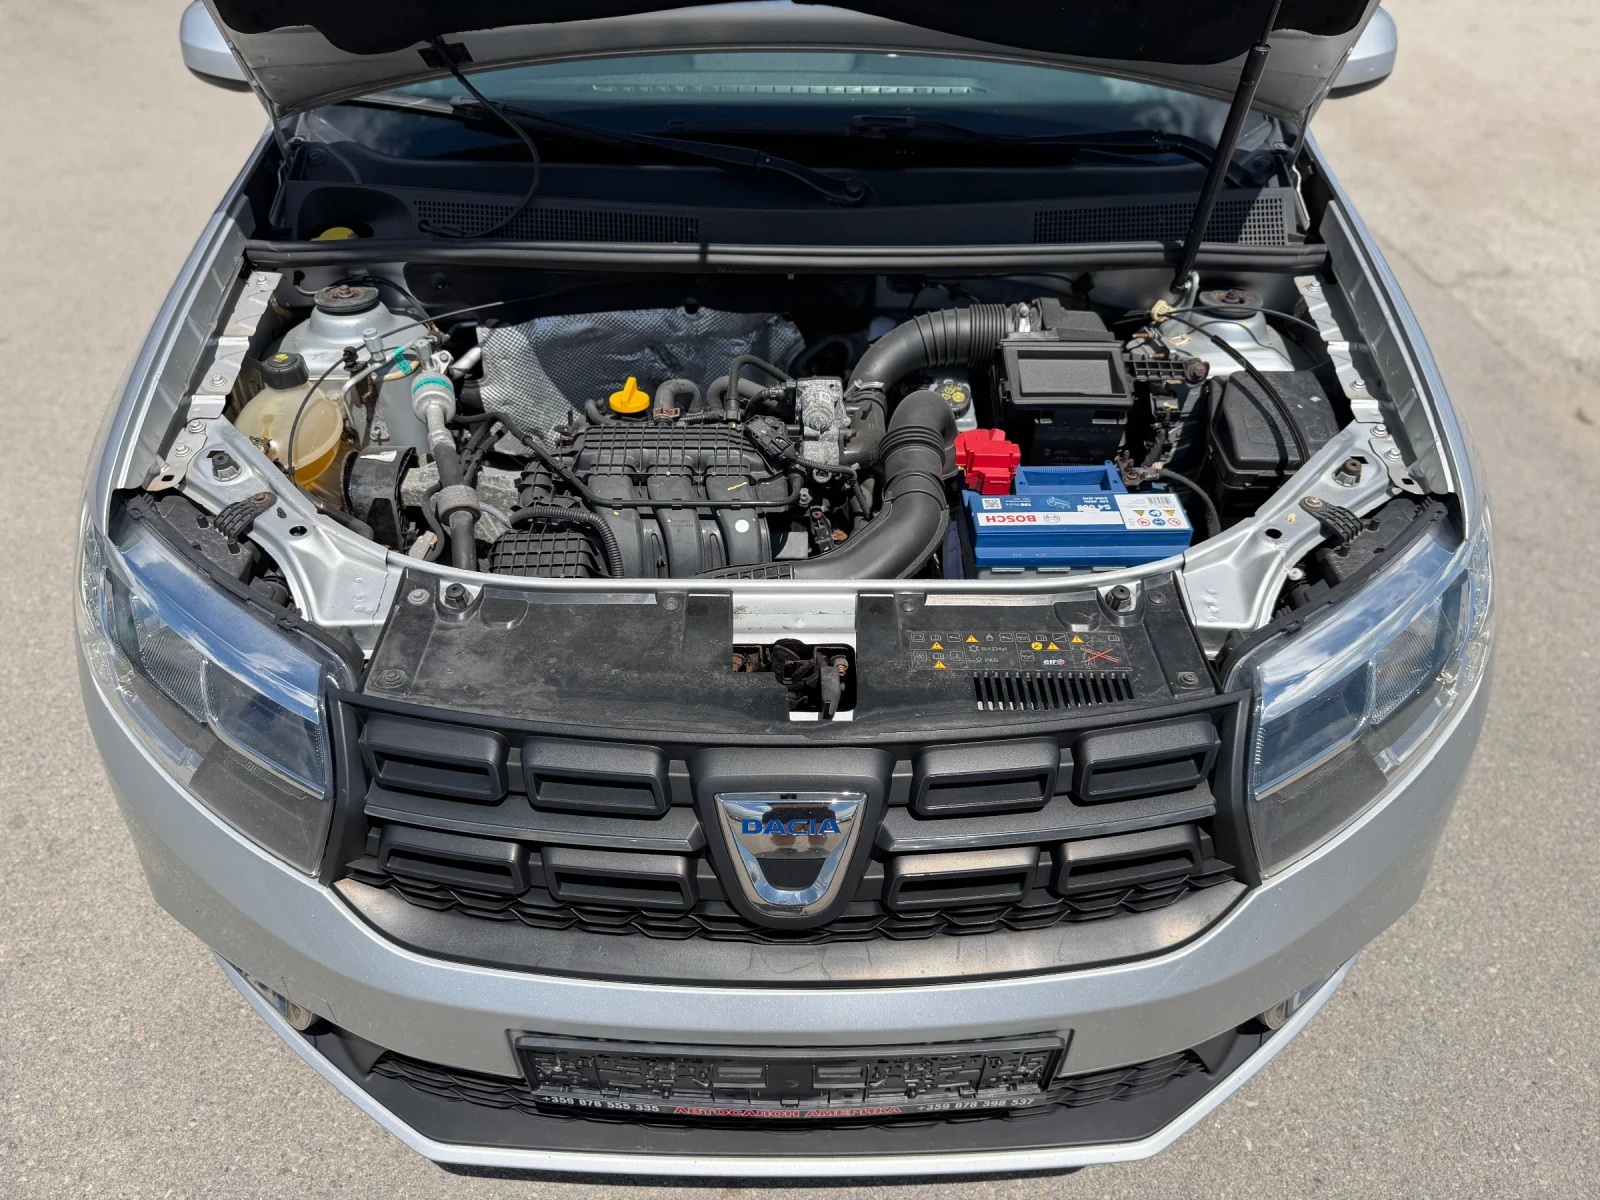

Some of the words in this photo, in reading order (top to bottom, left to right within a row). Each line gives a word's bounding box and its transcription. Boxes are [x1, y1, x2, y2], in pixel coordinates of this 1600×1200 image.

[985, 515, 1037, 523] BOSCH
[741, 818, 841, 836] DACIA
[542, 1096, 575, 1105] +359
[578, 1099, 602, 1107] 878
[607, 1101, 631, 1110] 555
[635, 1104, 660, 1112] 335
[917, 1103, 950, 1111] +359
[954, 1101, 978, 1109] 878
[1010, 1098, 1035, 1106] 537
[673, 1106, 800, 1118] АВТОСАЛОН
[804, 1106, 902, 1118] АМЕРИКА
